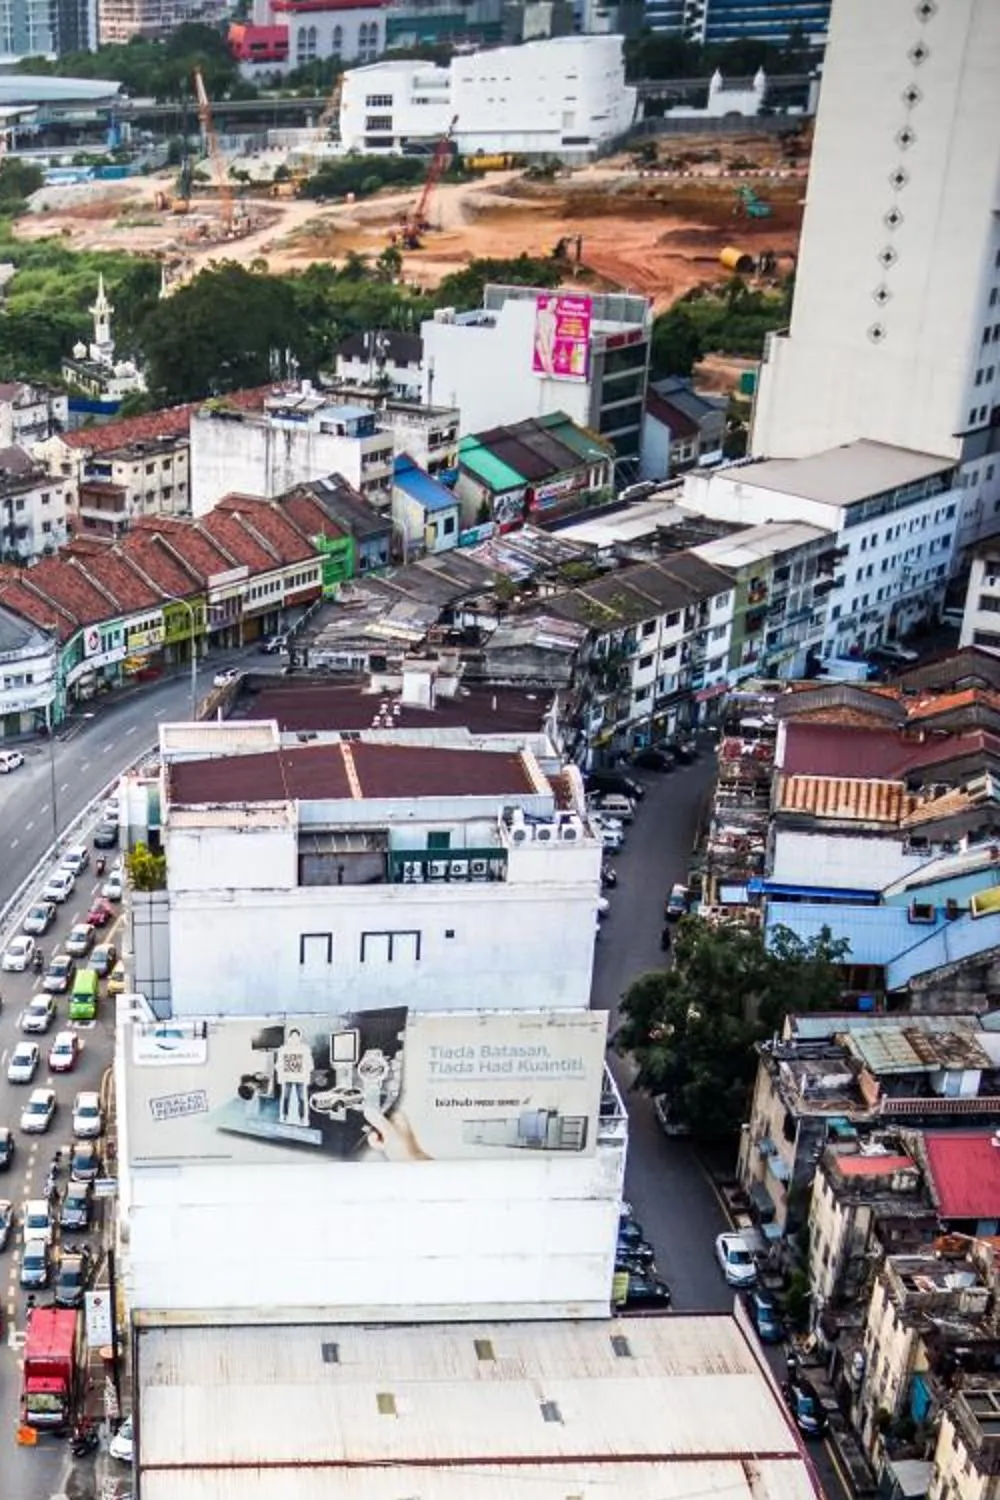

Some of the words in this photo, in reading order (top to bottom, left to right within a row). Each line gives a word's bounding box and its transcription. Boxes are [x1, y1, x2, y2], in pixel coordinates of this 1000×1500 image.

[429, 1046, 475, 1059] Tiada
[480, 1045, 551, 1059] Batasan,
[429, 1061, 473, 1074] Tiada
[479, 1059, 514, 1073] Had
